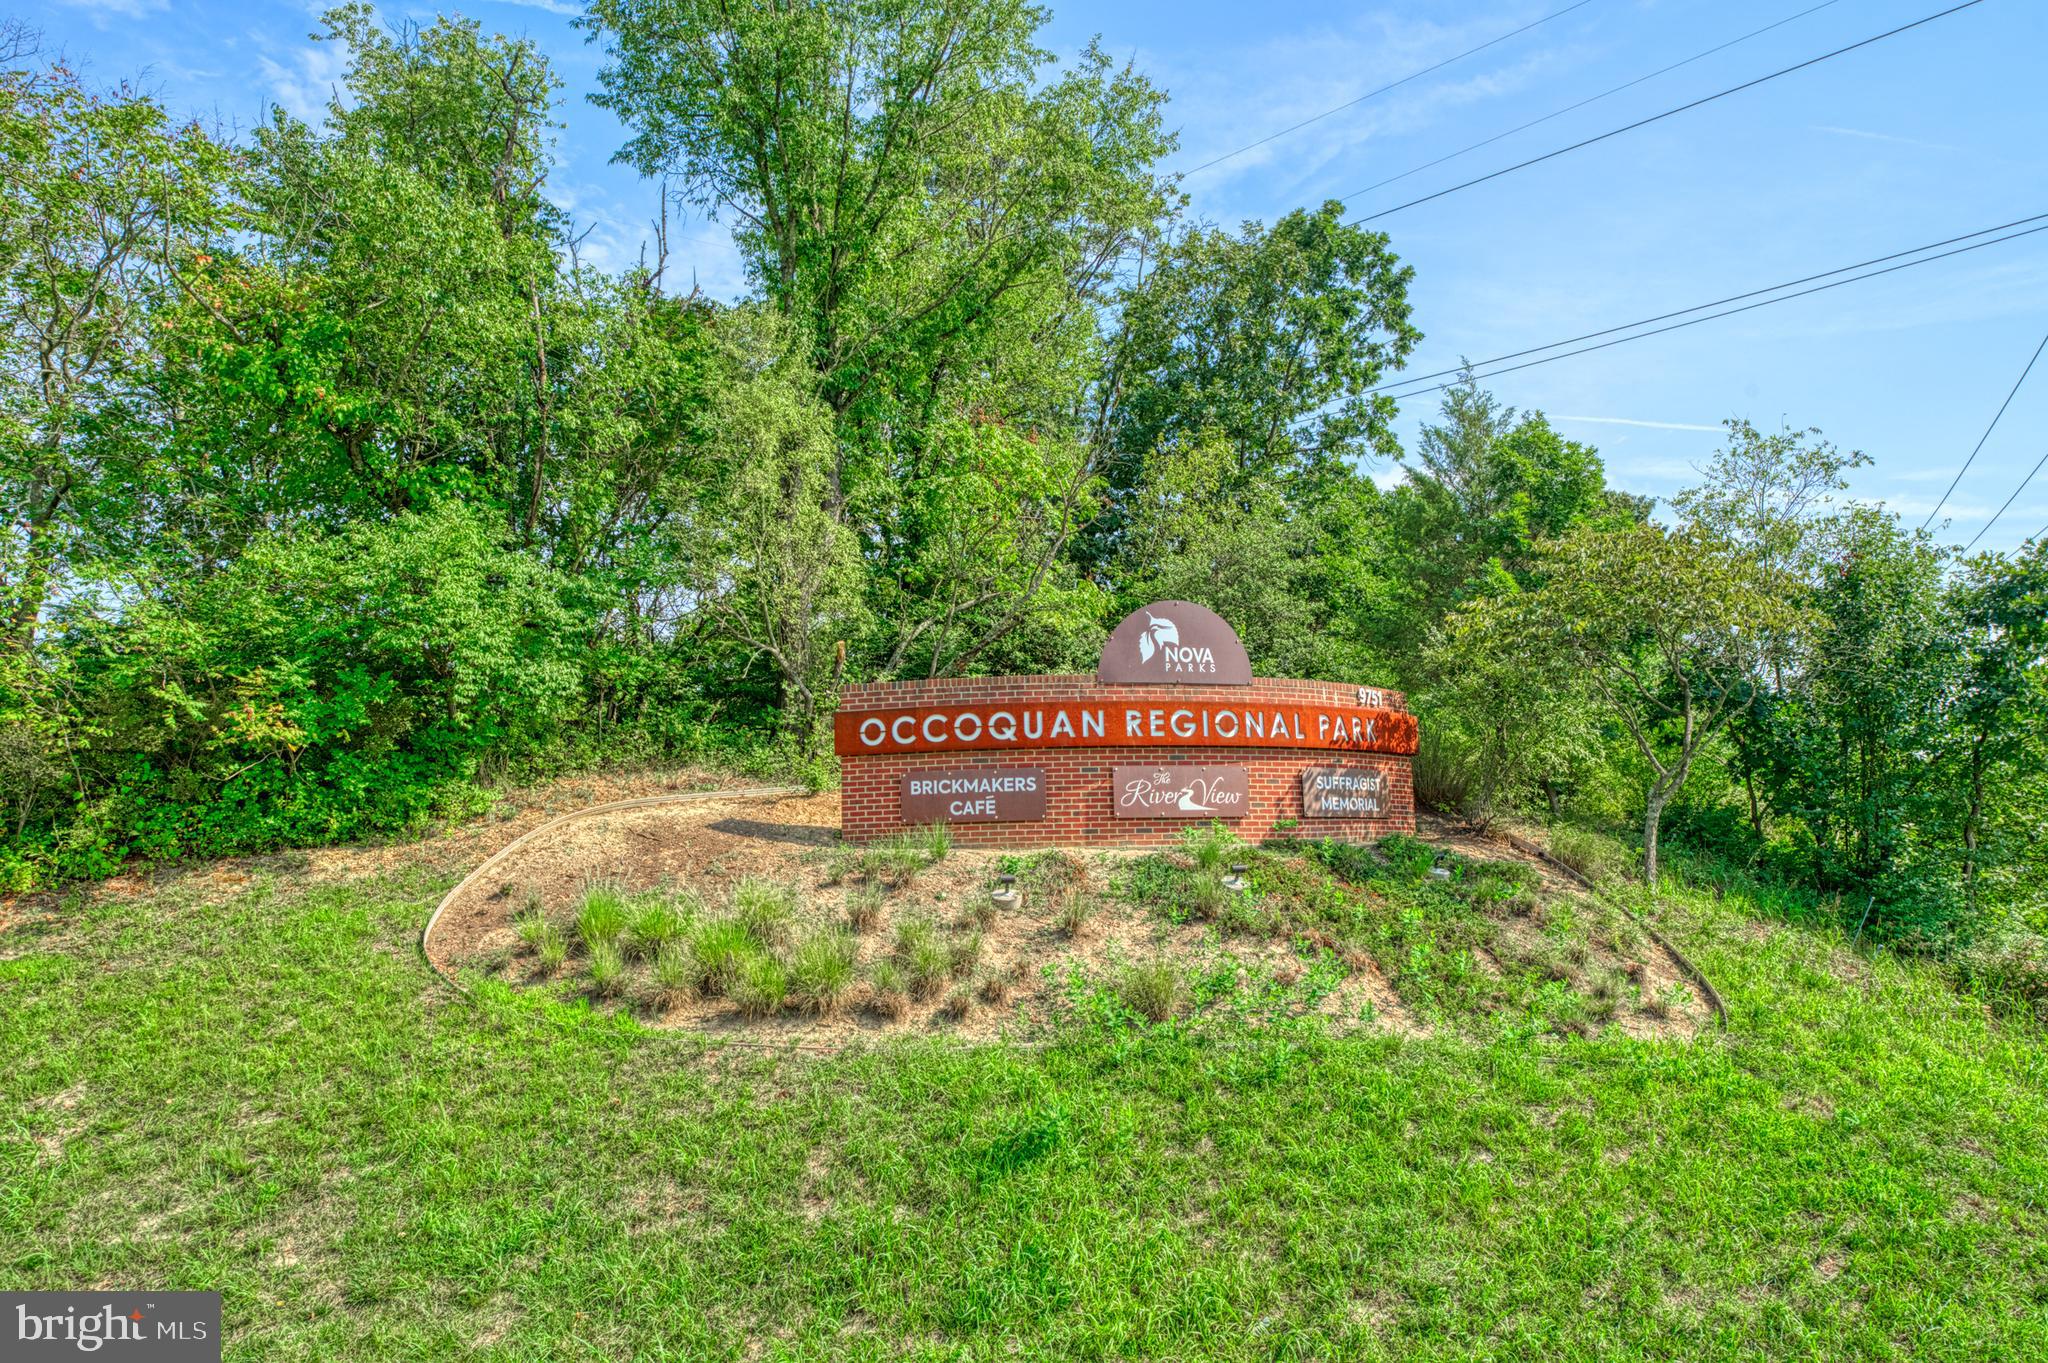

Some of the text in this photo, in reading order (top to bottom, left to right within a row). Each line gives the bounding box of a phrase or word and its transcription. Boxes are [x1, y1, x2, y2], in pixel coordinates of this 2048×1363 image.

[1165, 647, 1215, 664] NOVA
[1165, 663, 1216, 673] PARKS
[1358, 687, 1383, 706] 9751
[859, 709, 1378, 747] OCCOQUAN REGIONAL PARK
[909, 776, 1037, 796] BRICKMAKERS
[1153, 772, 1171, 785] The
[1316, 775, 1381, 792] SUFFRAGIST
[1120, 777, 1243, 807] River View
[949, 795, 996, 816] CAFÉ
[1321, 796, 1380, 811] MEMORIAL
